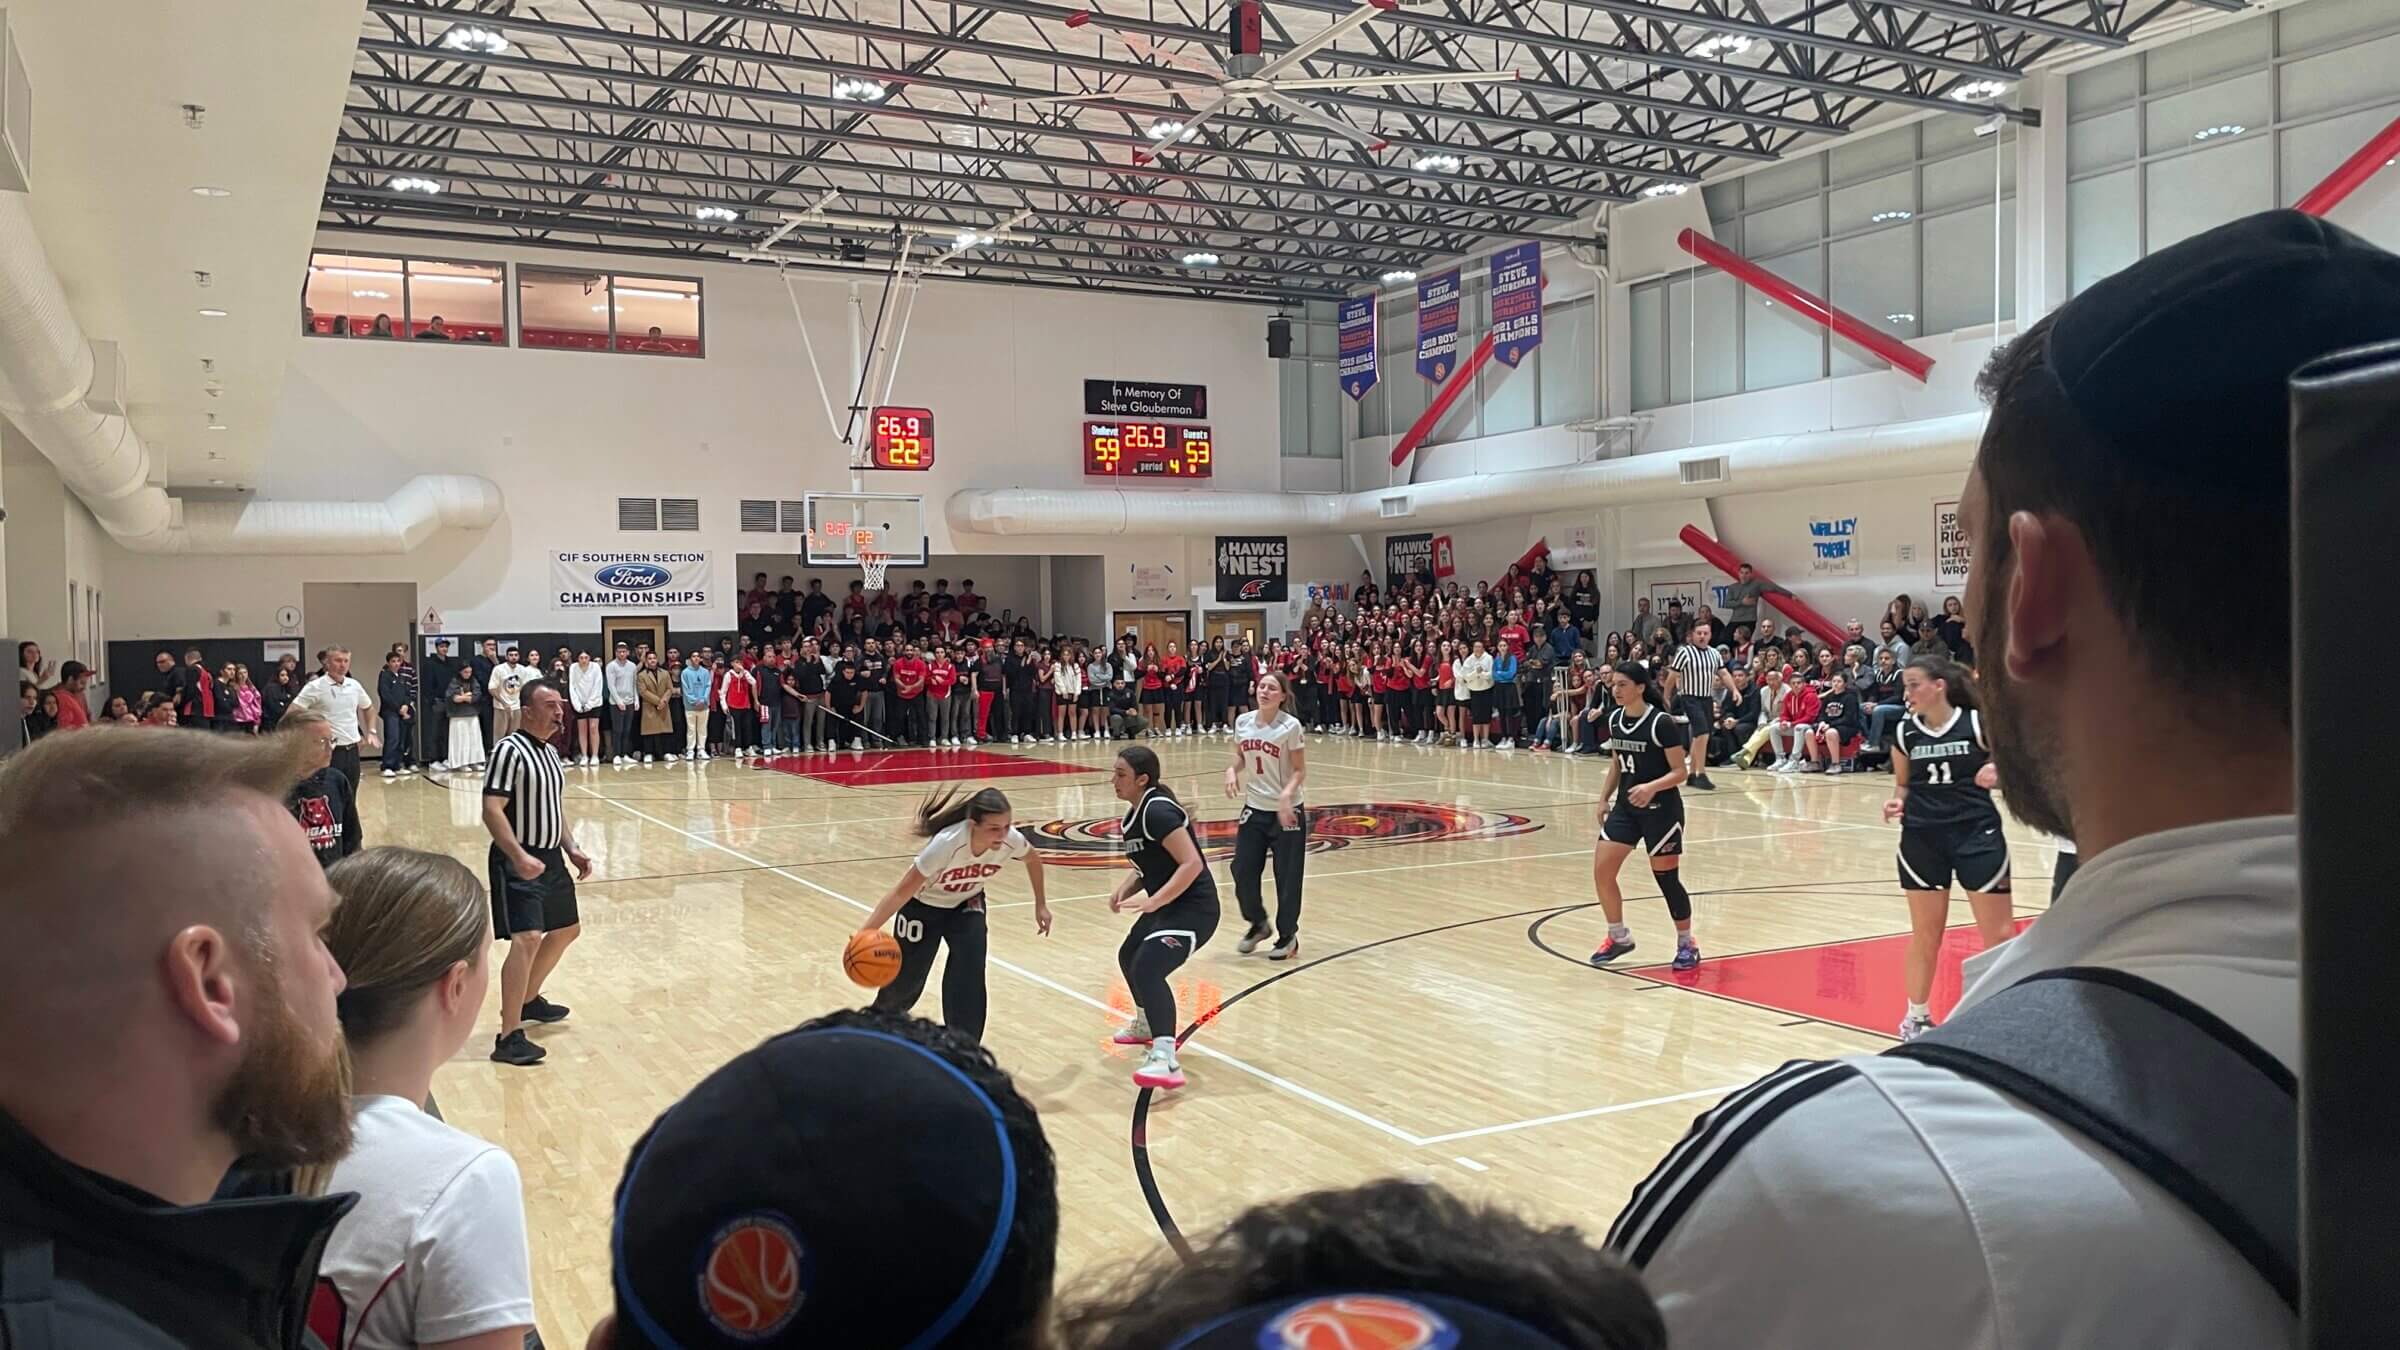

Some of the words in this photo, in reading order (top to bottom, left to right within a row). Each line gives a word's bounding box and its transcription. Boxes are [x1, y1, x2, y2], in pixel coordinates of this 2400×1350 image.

[1499, 266, 1528, 284] STEVE
[1113, 386, 1122, 396] In
[1125, 387, 1165, 401] Memory
[1168, 388, 1181, 400] Of
[1101, 400, 1127, 411] Steve
[1130, 401, 1192, 415] Glouberman
[878, 416, 919, 437] 26.9
[1125, 425, 1166, 448] 26.9
[889, 438, 920, 464] 22
[1095, 437, 1120, 460] 59
[1186, 441, 1210, 463] 53
[1140, 462, 1163, 472] period
[1169, 459, 1180, 473] 4
[1809, 517, 1857, 536] VALLEY
[1941, 531, 1967, 543] RIG
[559, 553, 579, 562] CIF
[582, 553, 650, 562] SOUTHERN
[653, 553, 704, 562] SECTION
[1228, 542, 1285, 556] HAWKS
[1394, 541, 1431, 555] HAWKS
[1230, 556, 1285, 575] NEST
[1942, 565, 1968, 575] WRO
[610, 567, 656, 586] Ford
[560, 592, 705, 603] CHAMPIONSHIPS
[1256, 756, 1264, 774] 1
[1619, 754, 1635, 773] 14
[1927, 761, 1954, 784] 11
[939, 864, 1002, 883] FRISC
[897, 913, 923, 942] 00
